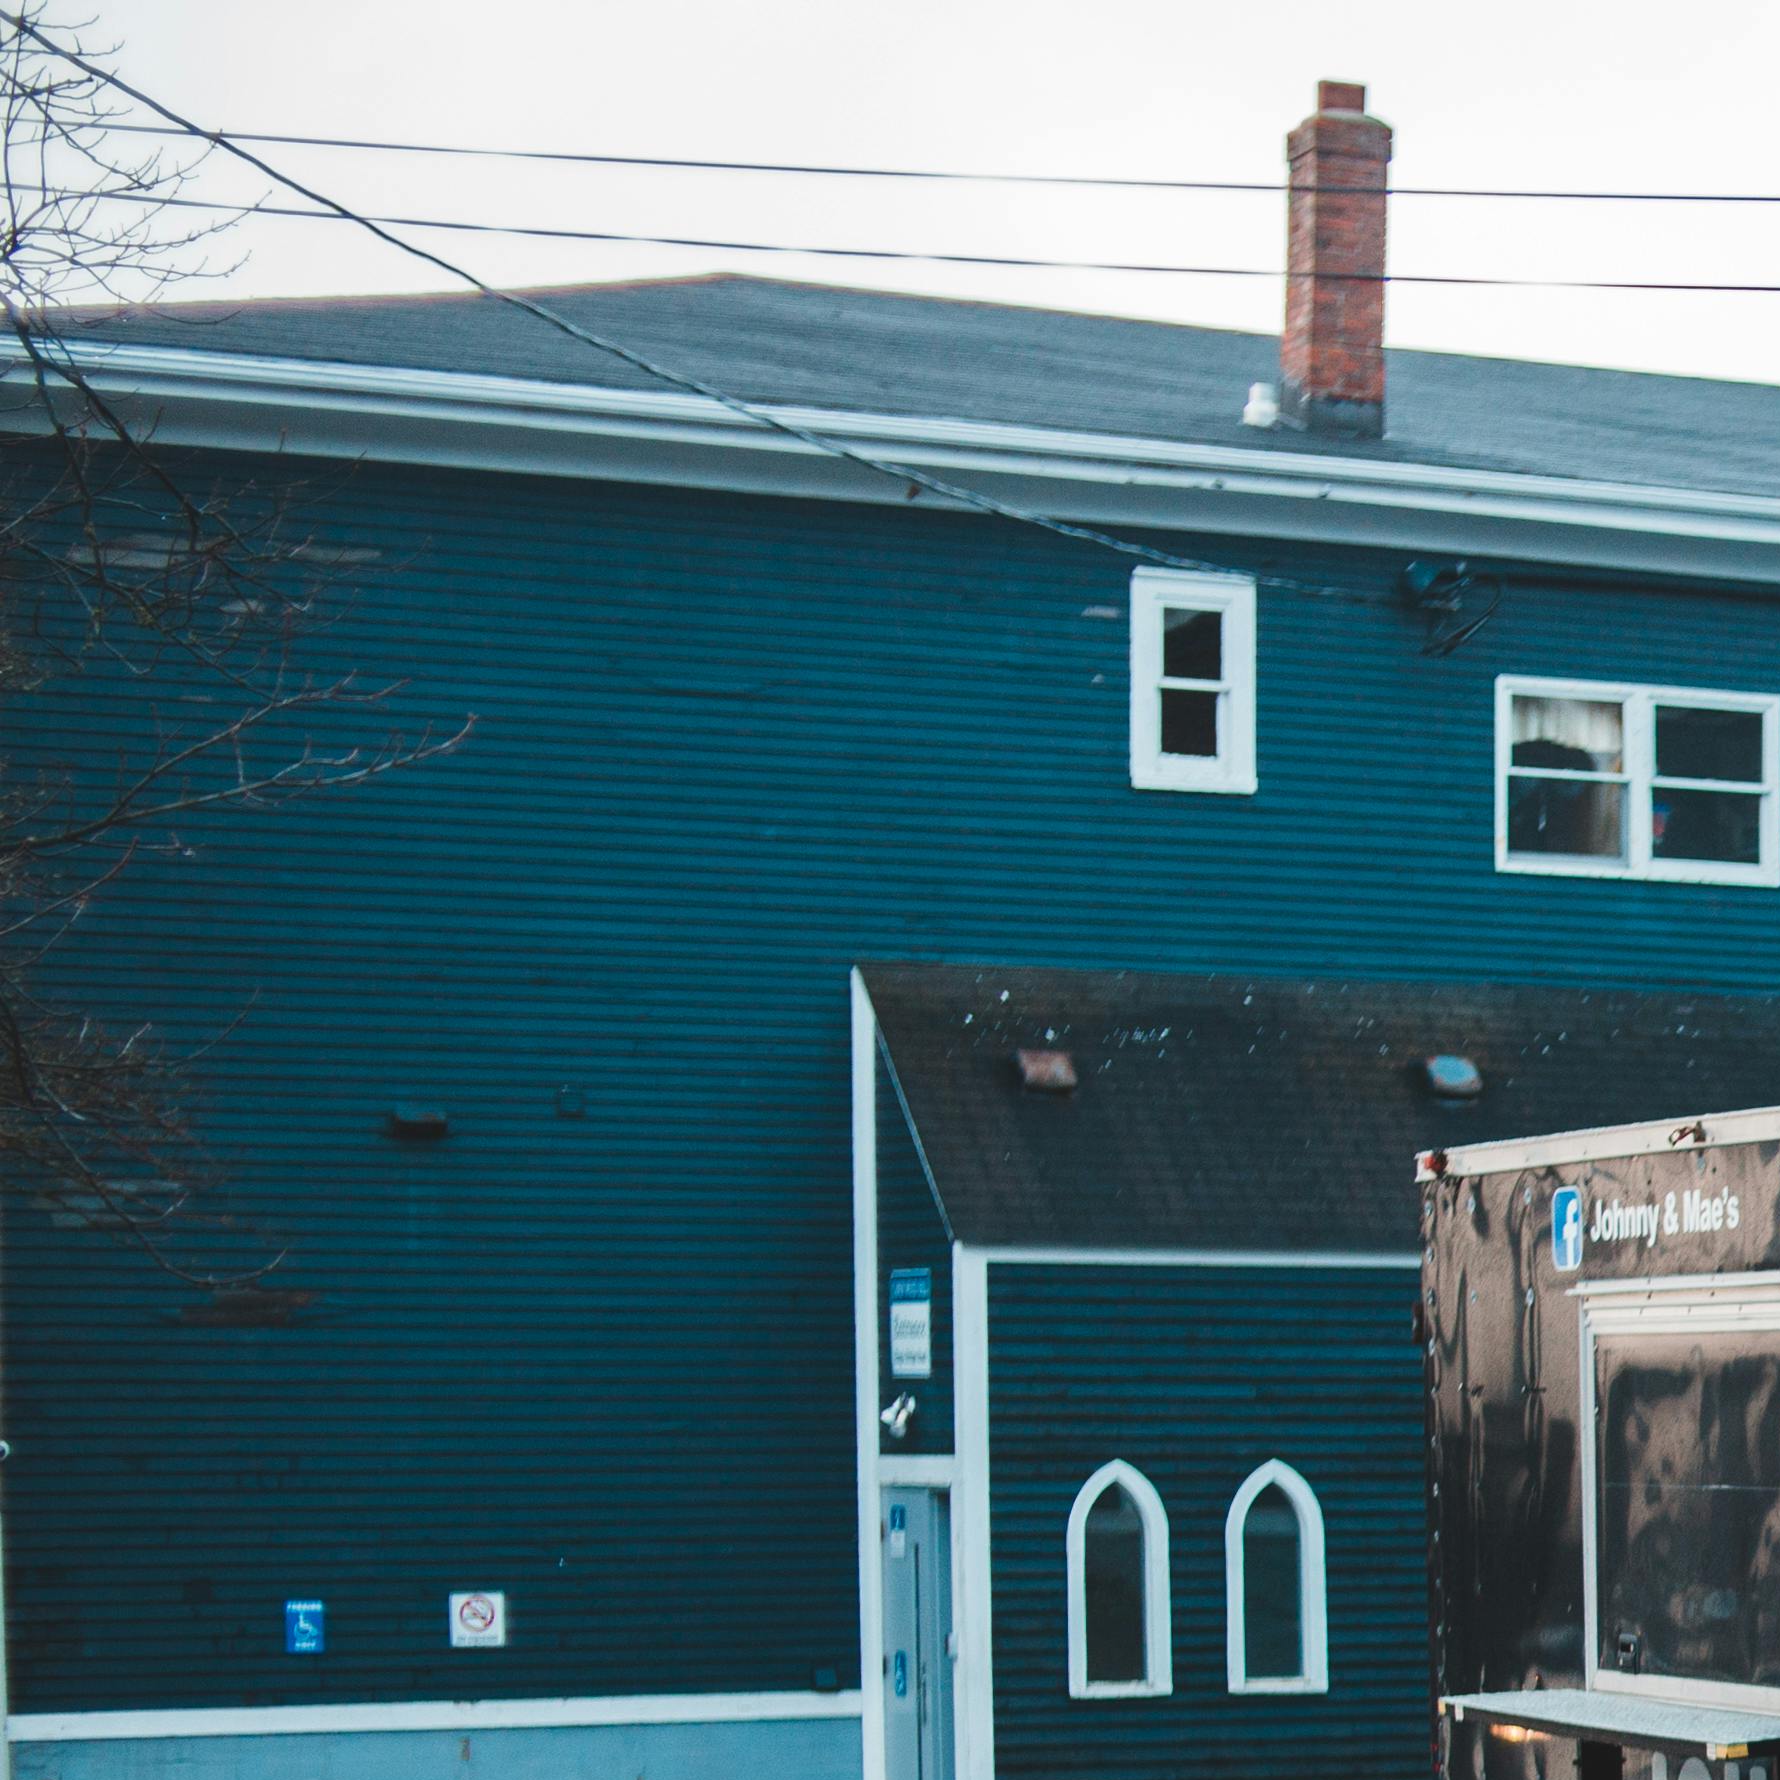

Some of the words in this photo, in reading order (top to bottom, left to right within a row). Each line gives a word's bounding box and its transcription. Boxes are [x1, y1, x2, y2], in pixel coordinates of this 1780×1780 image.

[1590, 1198, 1660, 1248] Johnny
[1663, 1191, 1680, 1236] &
[1683, 1185, 1741, 1233] Mae's
